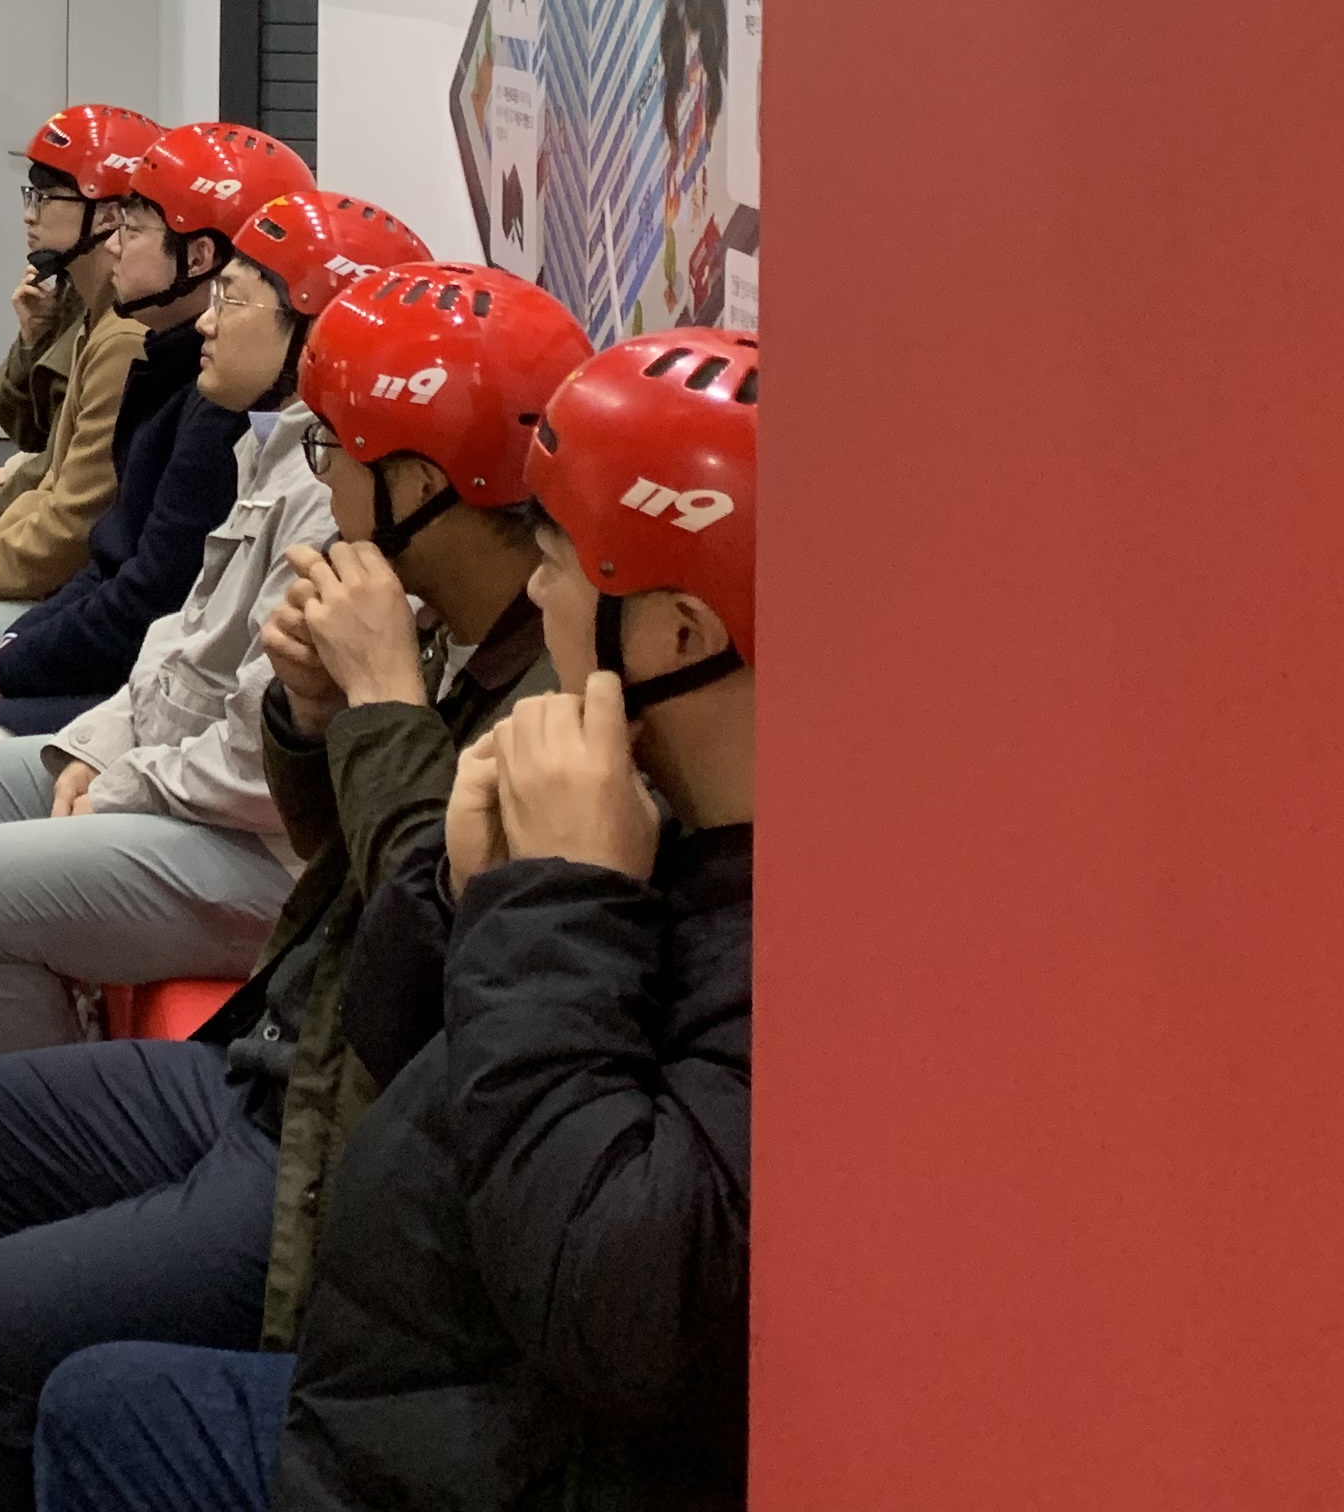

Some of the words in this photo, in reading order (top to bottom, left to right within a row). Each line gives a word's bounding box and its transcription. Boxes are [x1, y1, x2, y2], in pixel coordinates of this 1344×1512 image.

[189, 176, 242, 200] 119
[370, 367, 448, 405] 119
[619, 476, 735, 533] 119
